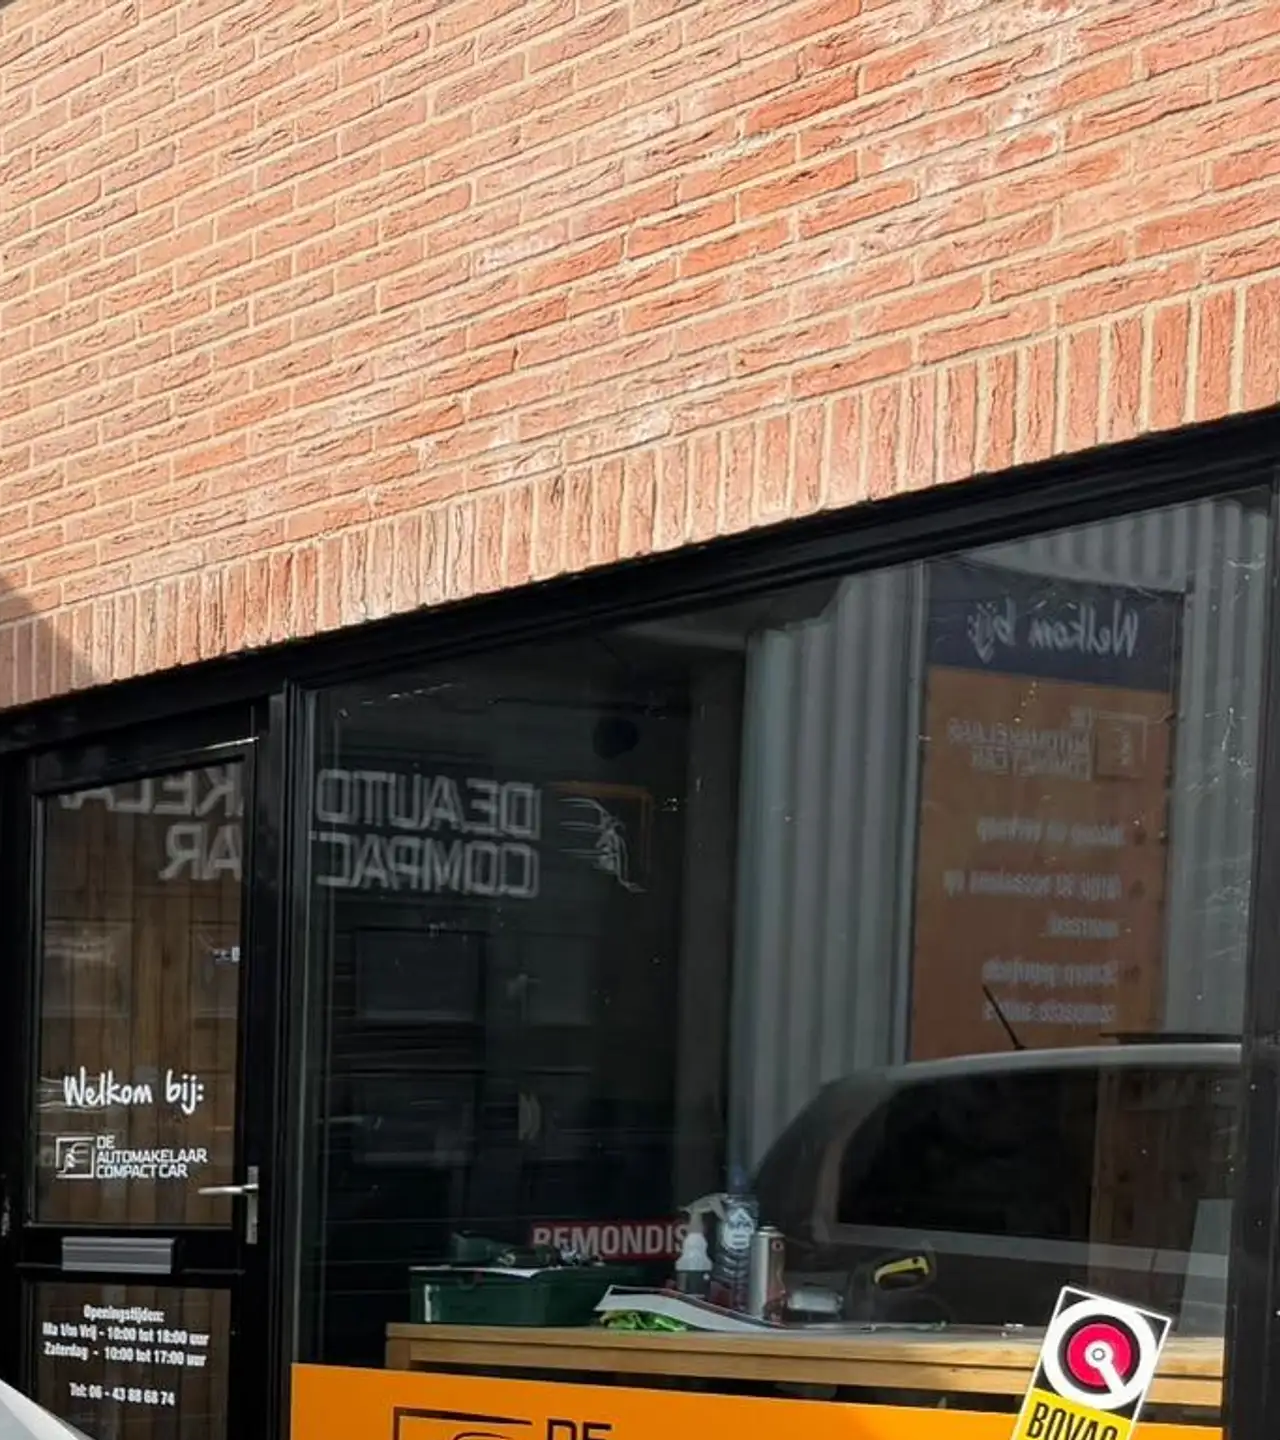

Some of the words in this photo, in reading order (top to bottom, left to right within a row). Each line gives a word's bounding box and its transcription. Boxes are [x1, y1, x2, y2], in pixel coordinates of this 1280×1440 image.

[63, 1065, 153, 1107] Welkom
[165, 1068, 204, 1115] bij:
[96, 1135, 116, 1149] DE
[96, 1148, 209, 1164] AUTOMAKELAAR
[95, 1163, 159, 1179] COMPACT
[159, 1163, 189, 1178] CAR
